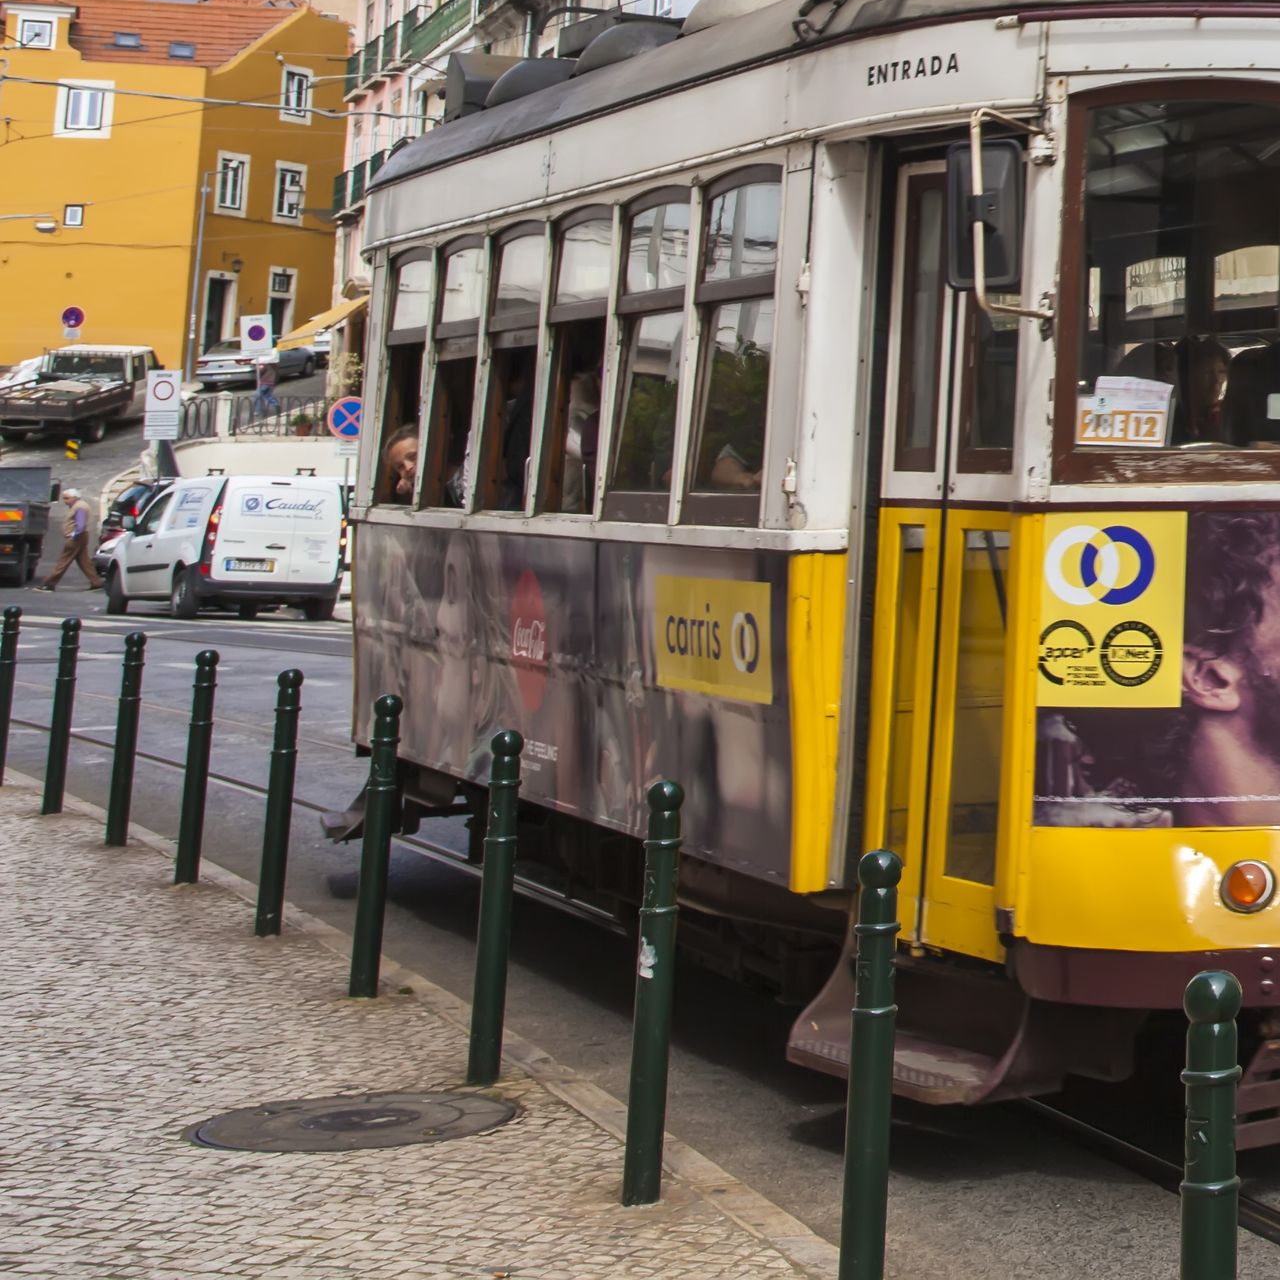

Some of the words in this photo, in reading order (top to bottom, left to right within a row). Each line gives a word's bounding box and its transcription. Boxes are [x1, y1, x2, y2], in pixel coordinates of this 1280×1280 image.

[867, 52, 959, 86] ENTRADA
[1081, 413, 1127, 438] 28E
[1132, 416, 1158, 438] 12
[666, 602, 722, 661] carris
